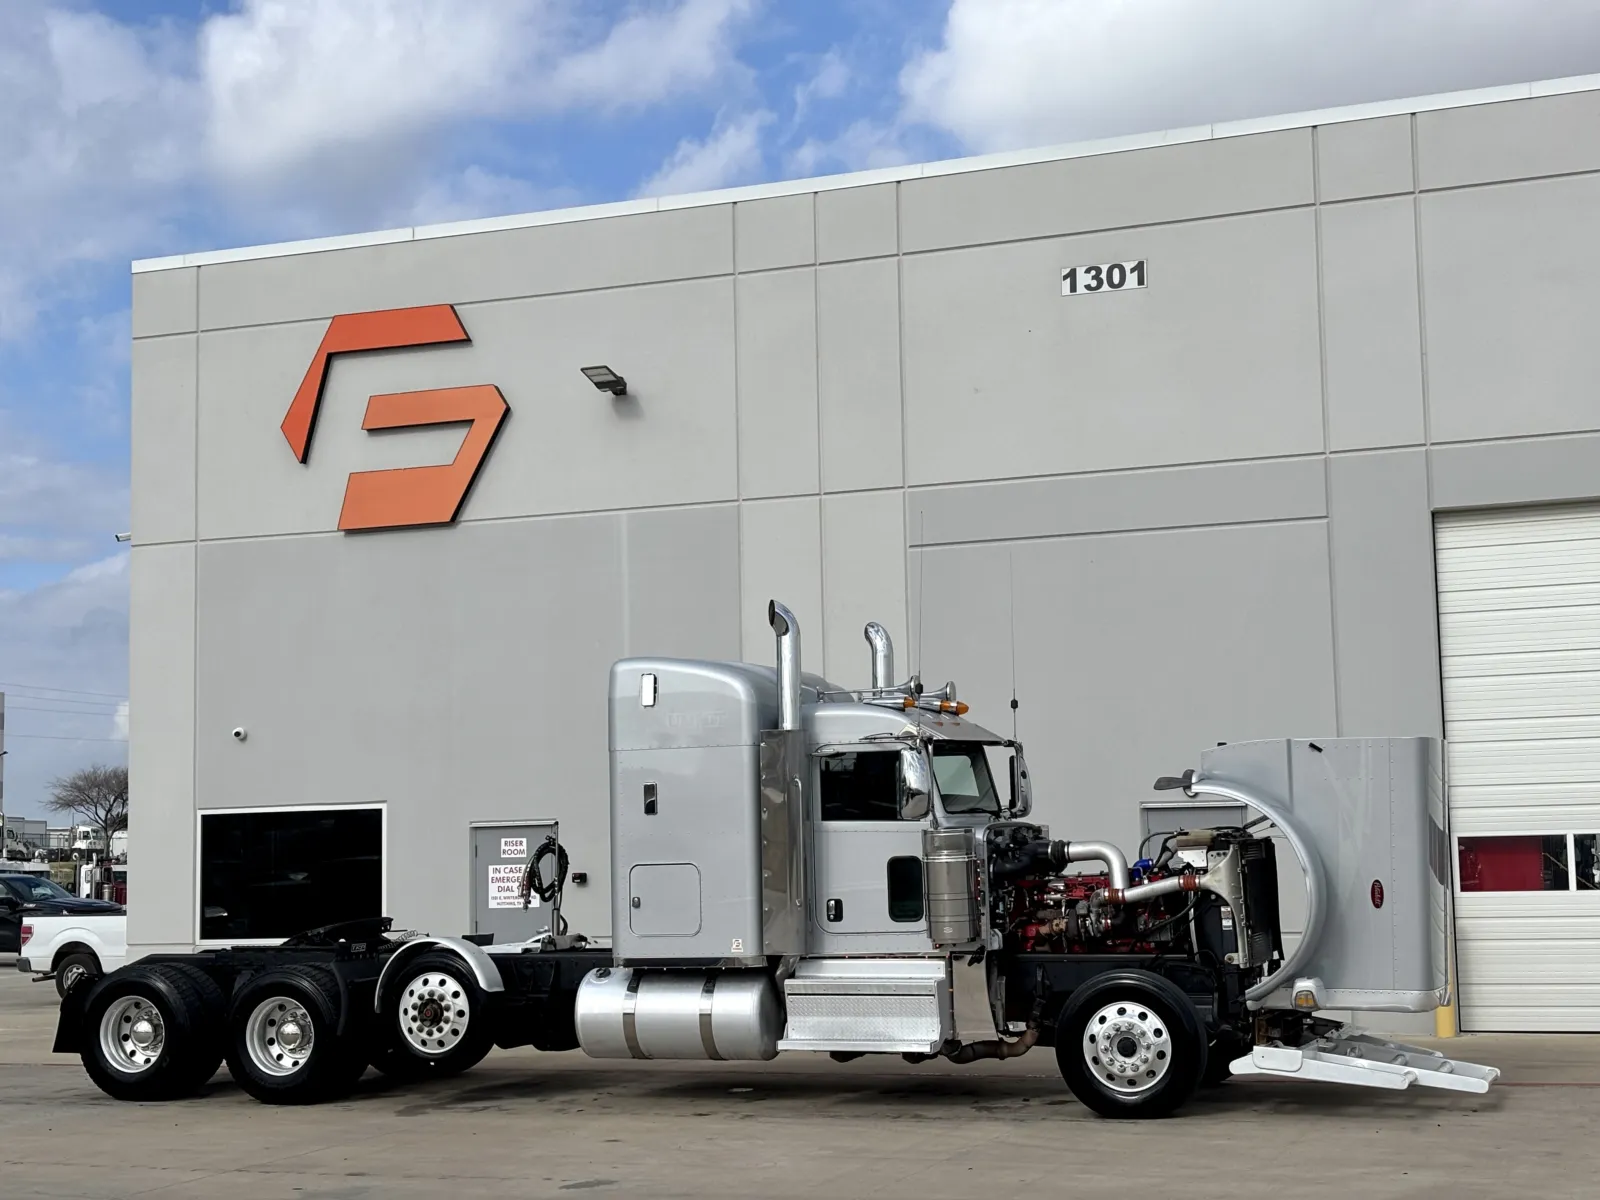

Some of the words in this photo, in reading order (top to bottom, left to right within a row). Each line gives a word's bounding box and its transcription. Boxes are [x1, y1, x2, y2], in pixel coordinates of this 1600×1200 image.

[1062, 260, 1145, 294] 1301
[502, 848, 526, 856] ROOM
[503, 866, 523, 874] CASE
[490, 876, 521, 884] EMERGE
[497, 885, 515, 893] DIAL
